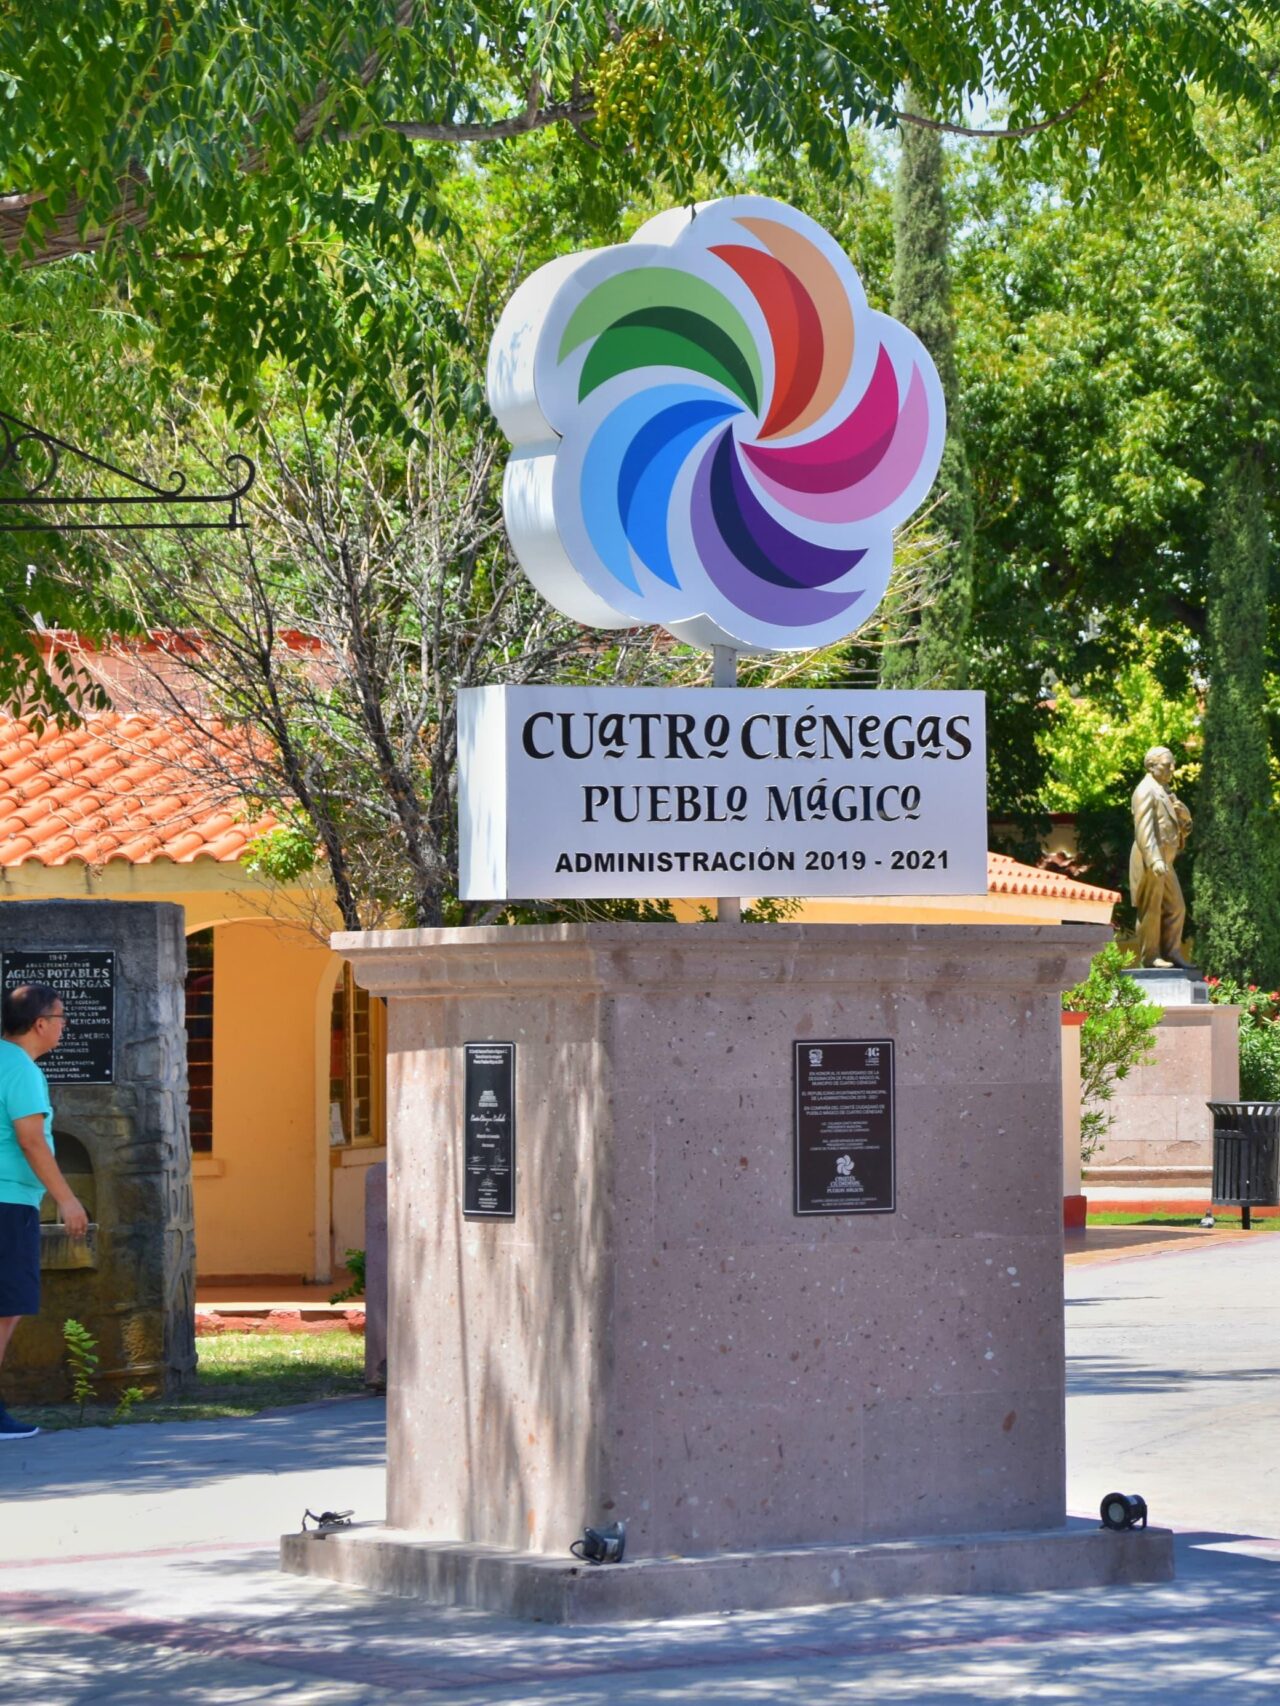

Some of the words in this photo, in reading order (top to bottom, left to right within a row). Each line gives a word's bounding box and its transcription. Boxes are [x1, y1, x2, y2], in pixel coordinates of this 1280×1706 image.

[555, 846, 795, 873] ADMINISTRACIÓN
[805, 850, 867, 871] 2019
[890, 849, 950, 870] 2021
[6, 969, 45, 979] AGUAS
[47, 968, 110, 979] POTABLES
[52, 979, 111, 989] CIENEGAS
[70, 1017, 111, 1025] MEXICANOS
[864, 1047, 880, 1057] 4C
